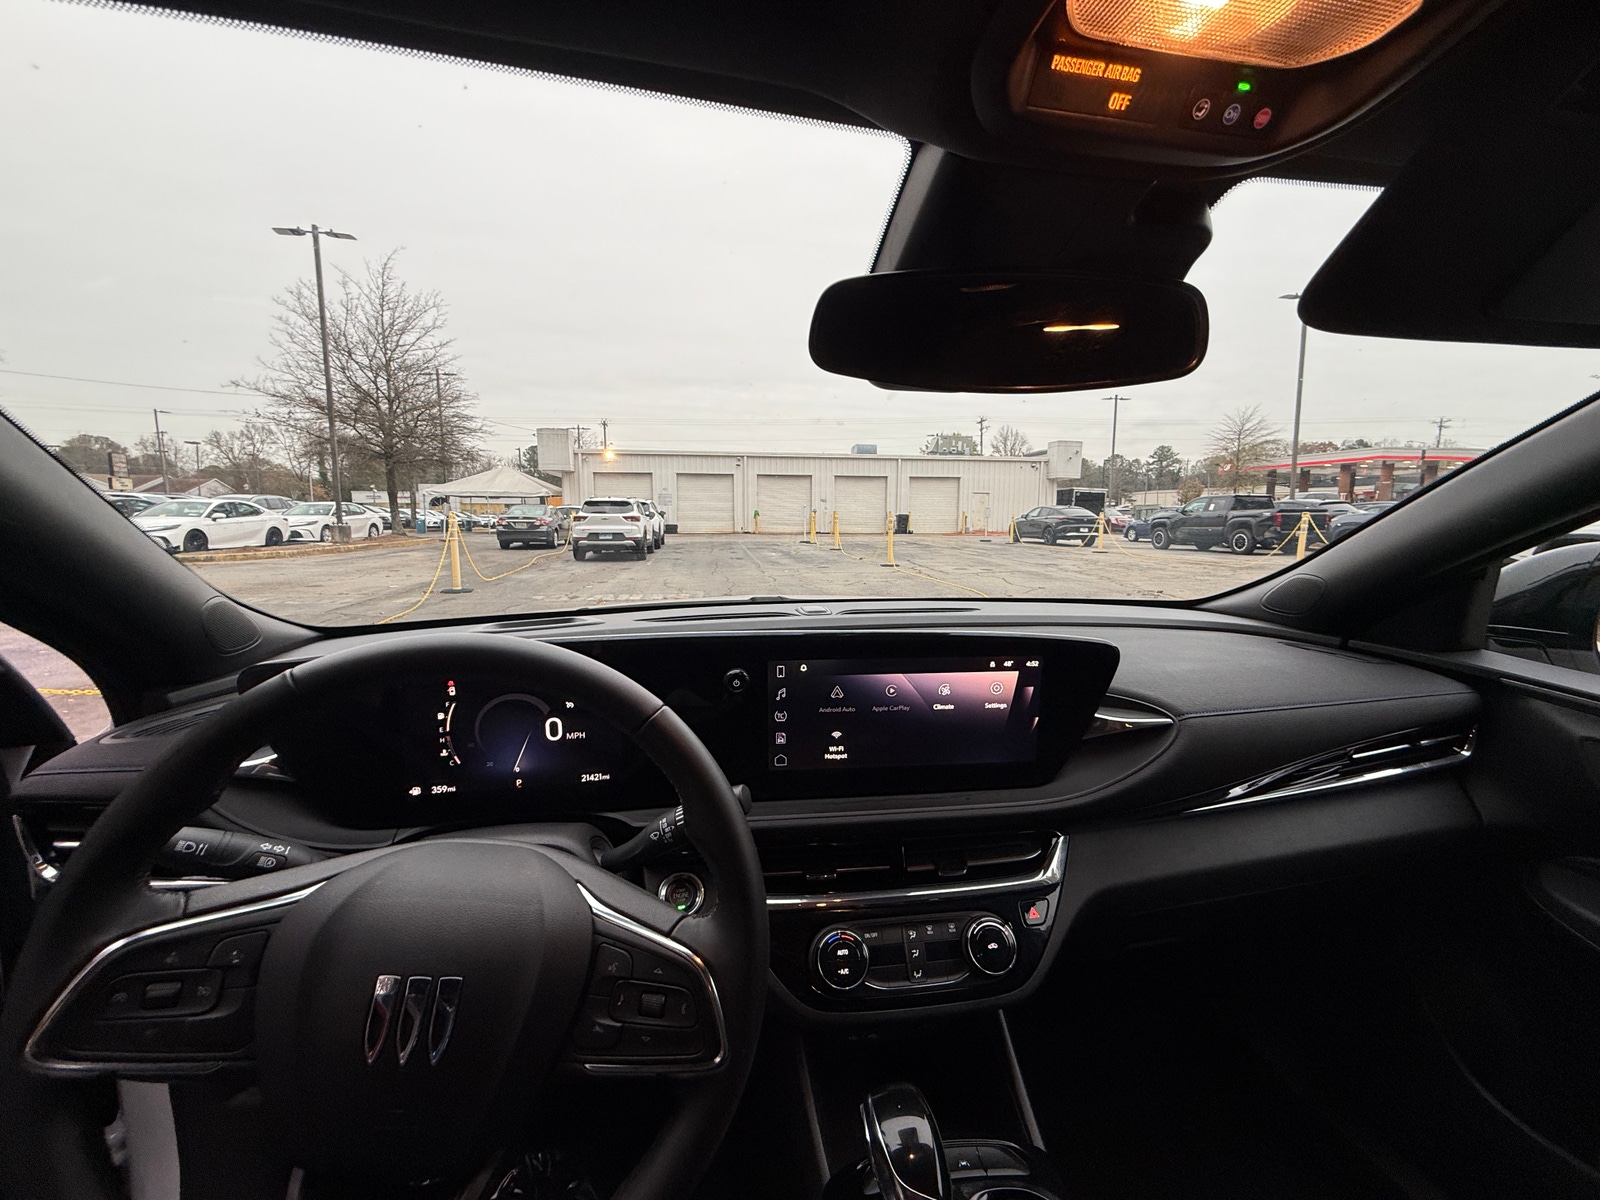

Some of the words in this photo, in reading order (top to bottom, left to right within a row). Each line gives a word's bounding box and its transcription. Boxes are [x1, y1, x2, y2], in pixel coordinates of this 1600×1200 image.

[1051, 54, 1106, 77] PASSENGER
[1108, 92, 1133, 111] OFF
[889, 704, 910, 712] CarPlay
[984, 702, 1008, 710] Settings
[545, 717, 563, 741] 0
[566, 731, 586, 740] MPH
[516, 779, 523, 787] P
